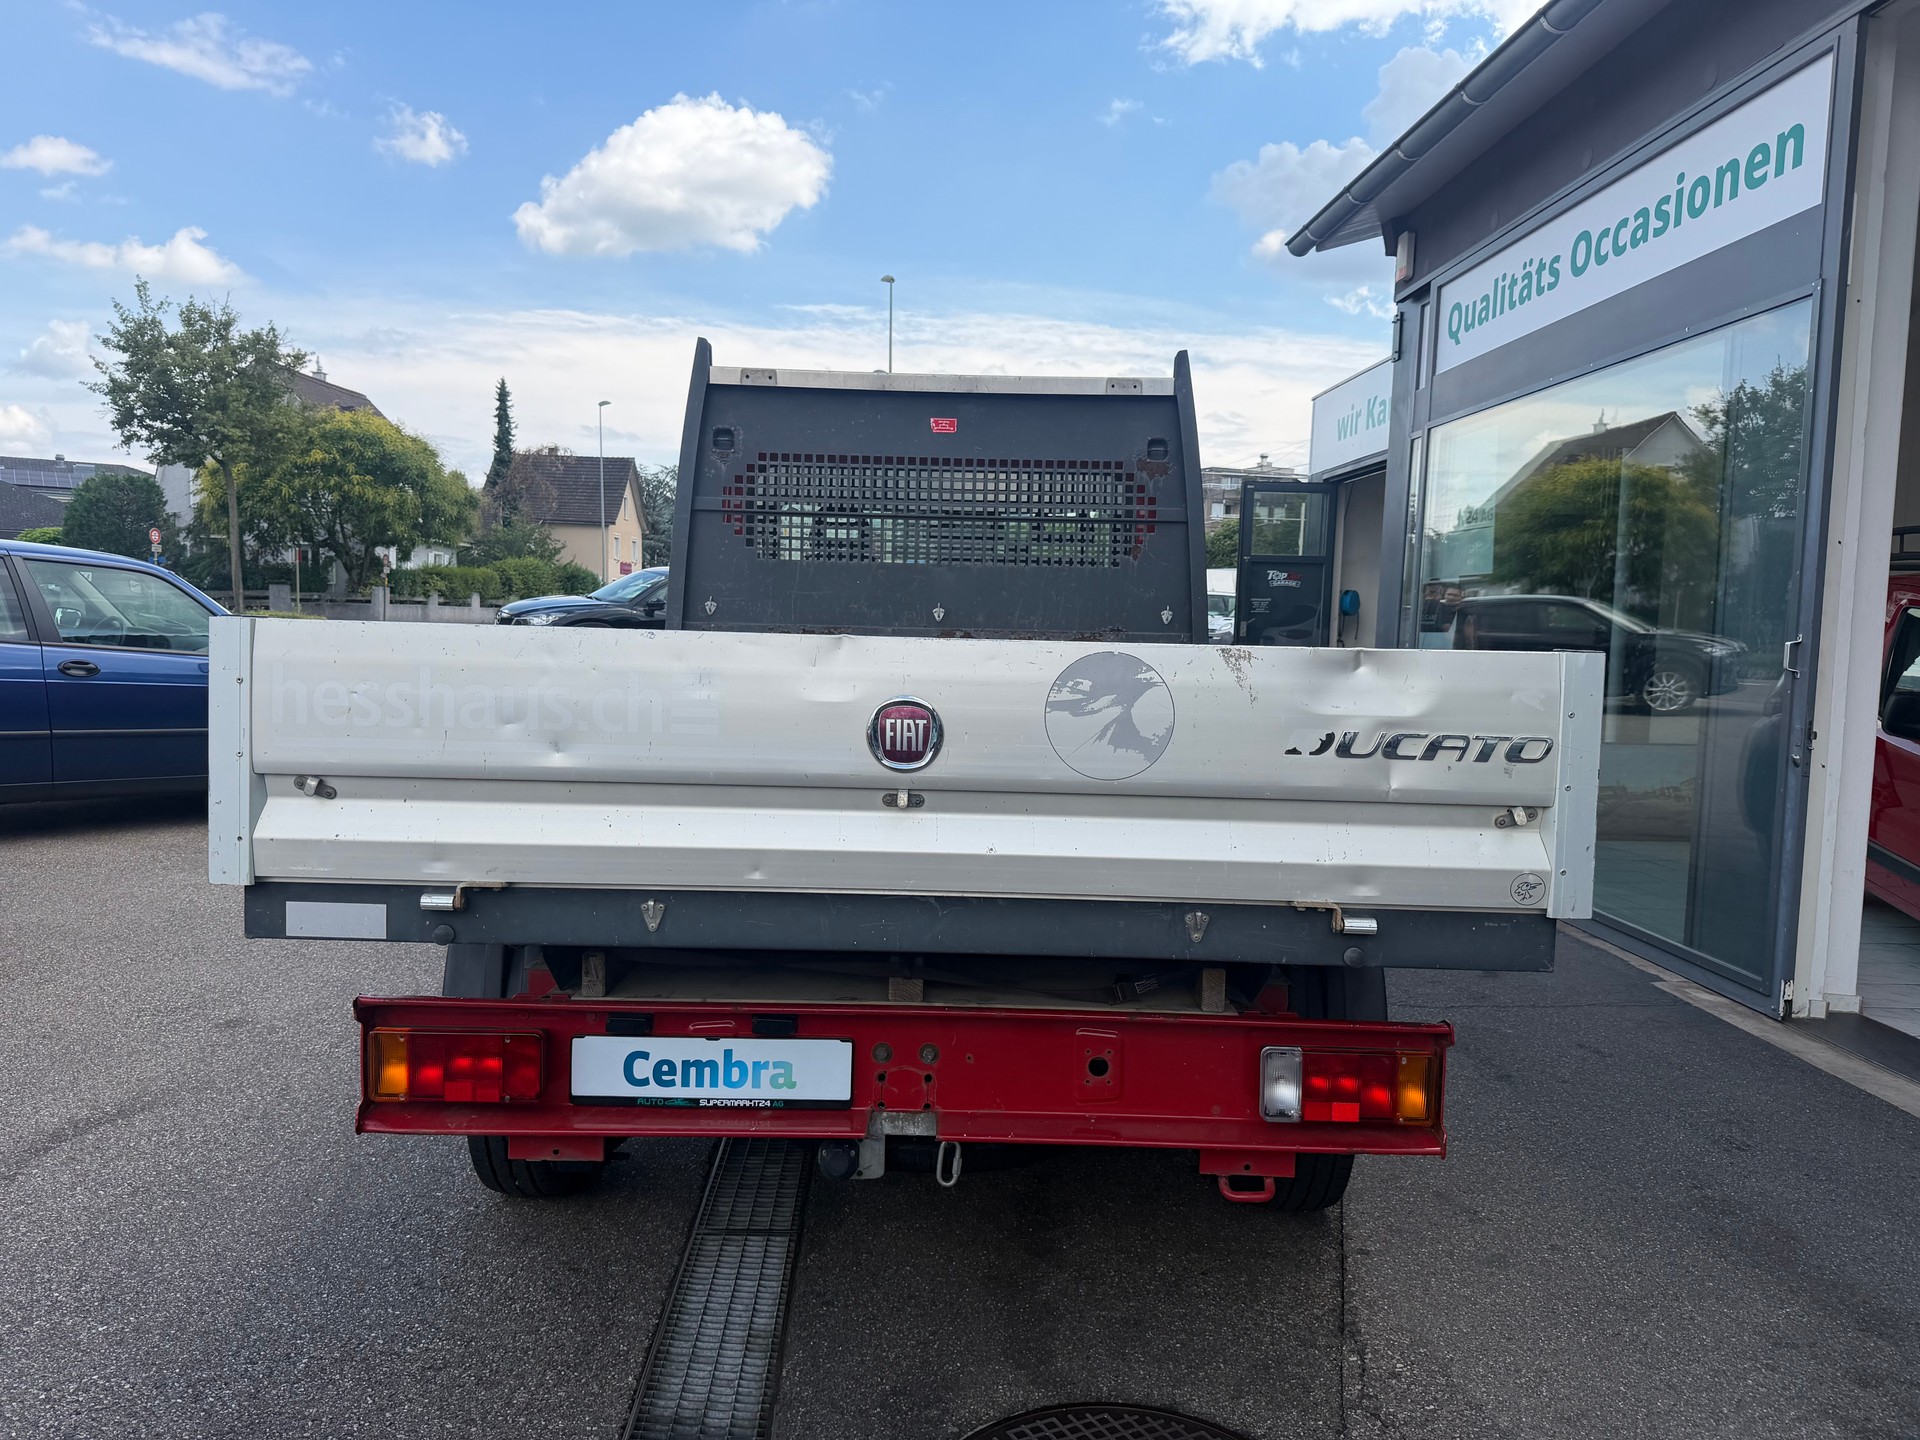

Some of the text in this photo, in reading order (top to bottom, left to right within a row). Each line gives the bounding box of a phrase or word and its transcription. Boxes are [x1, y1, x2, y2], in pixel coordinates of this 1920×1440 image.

[1448, 121, 1806, 346] Qualitäts Occasionen
[1337, 403, 1362, 441] wir
[272, 661, 664, 734] hesshaus.ch
[885, 718, 928, 752] FIAT
[623, 1049, 797, 1089] Cembra
[636, 1097, 784, 1108] AUTO SUPERMARKT24 AG
